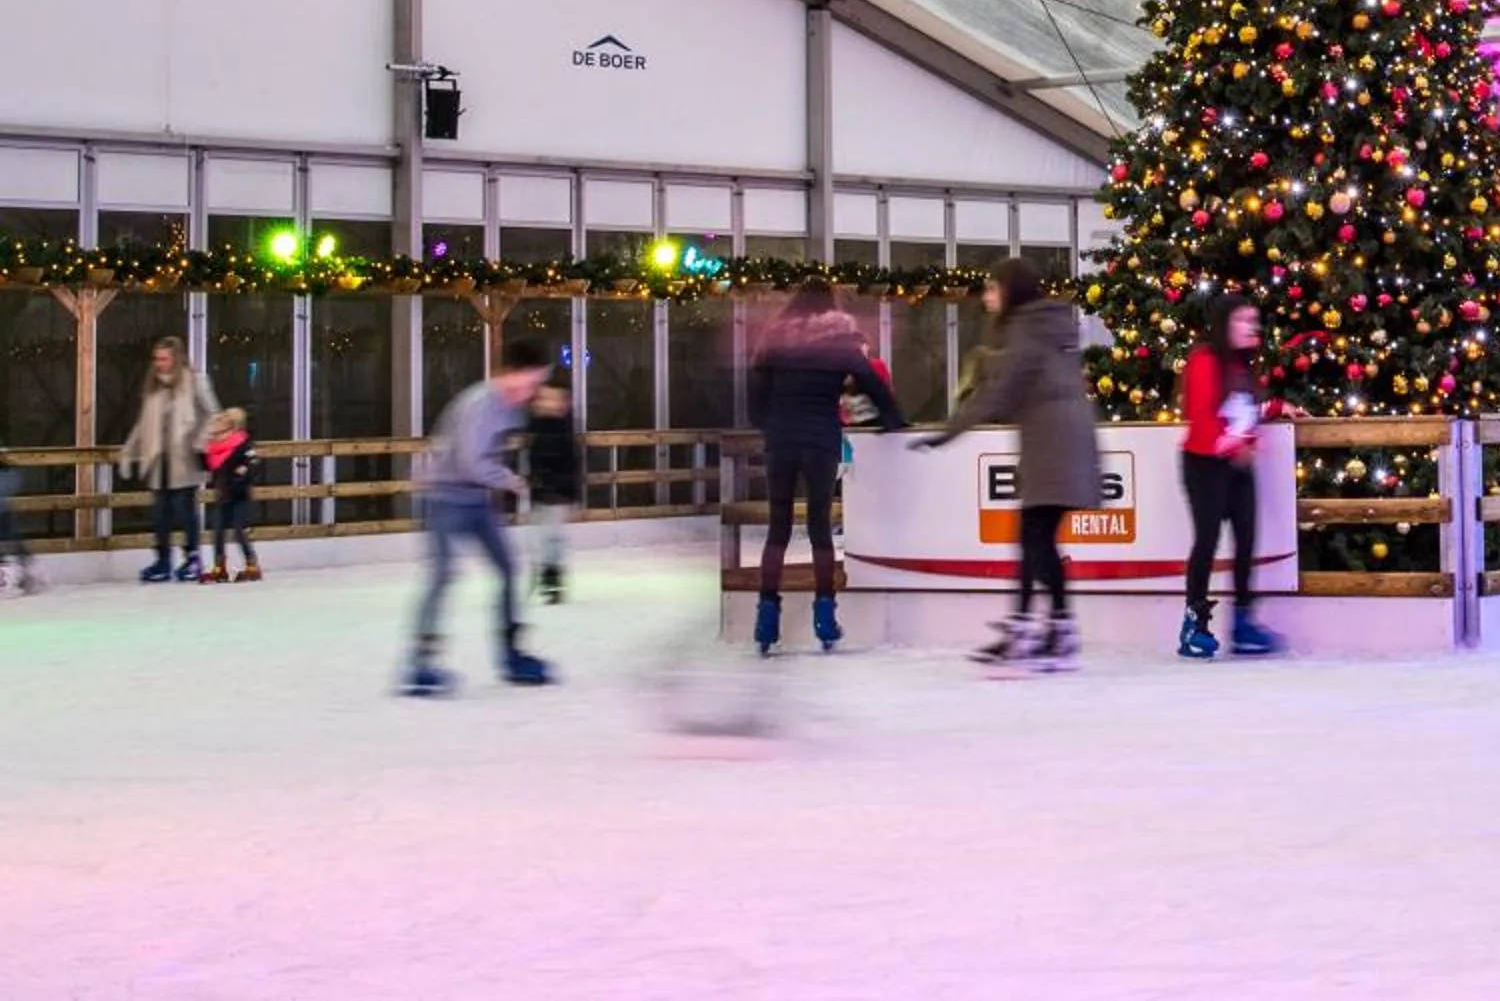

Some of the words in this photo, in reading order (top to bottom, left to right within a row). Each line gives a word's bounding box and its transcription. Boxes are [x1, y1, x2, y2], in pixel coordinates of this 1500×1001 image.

[572, 50, 595, 66] DE
[599, 52, 646, 70] BOER
[1071, 514, 1129, 536] RENTAL
